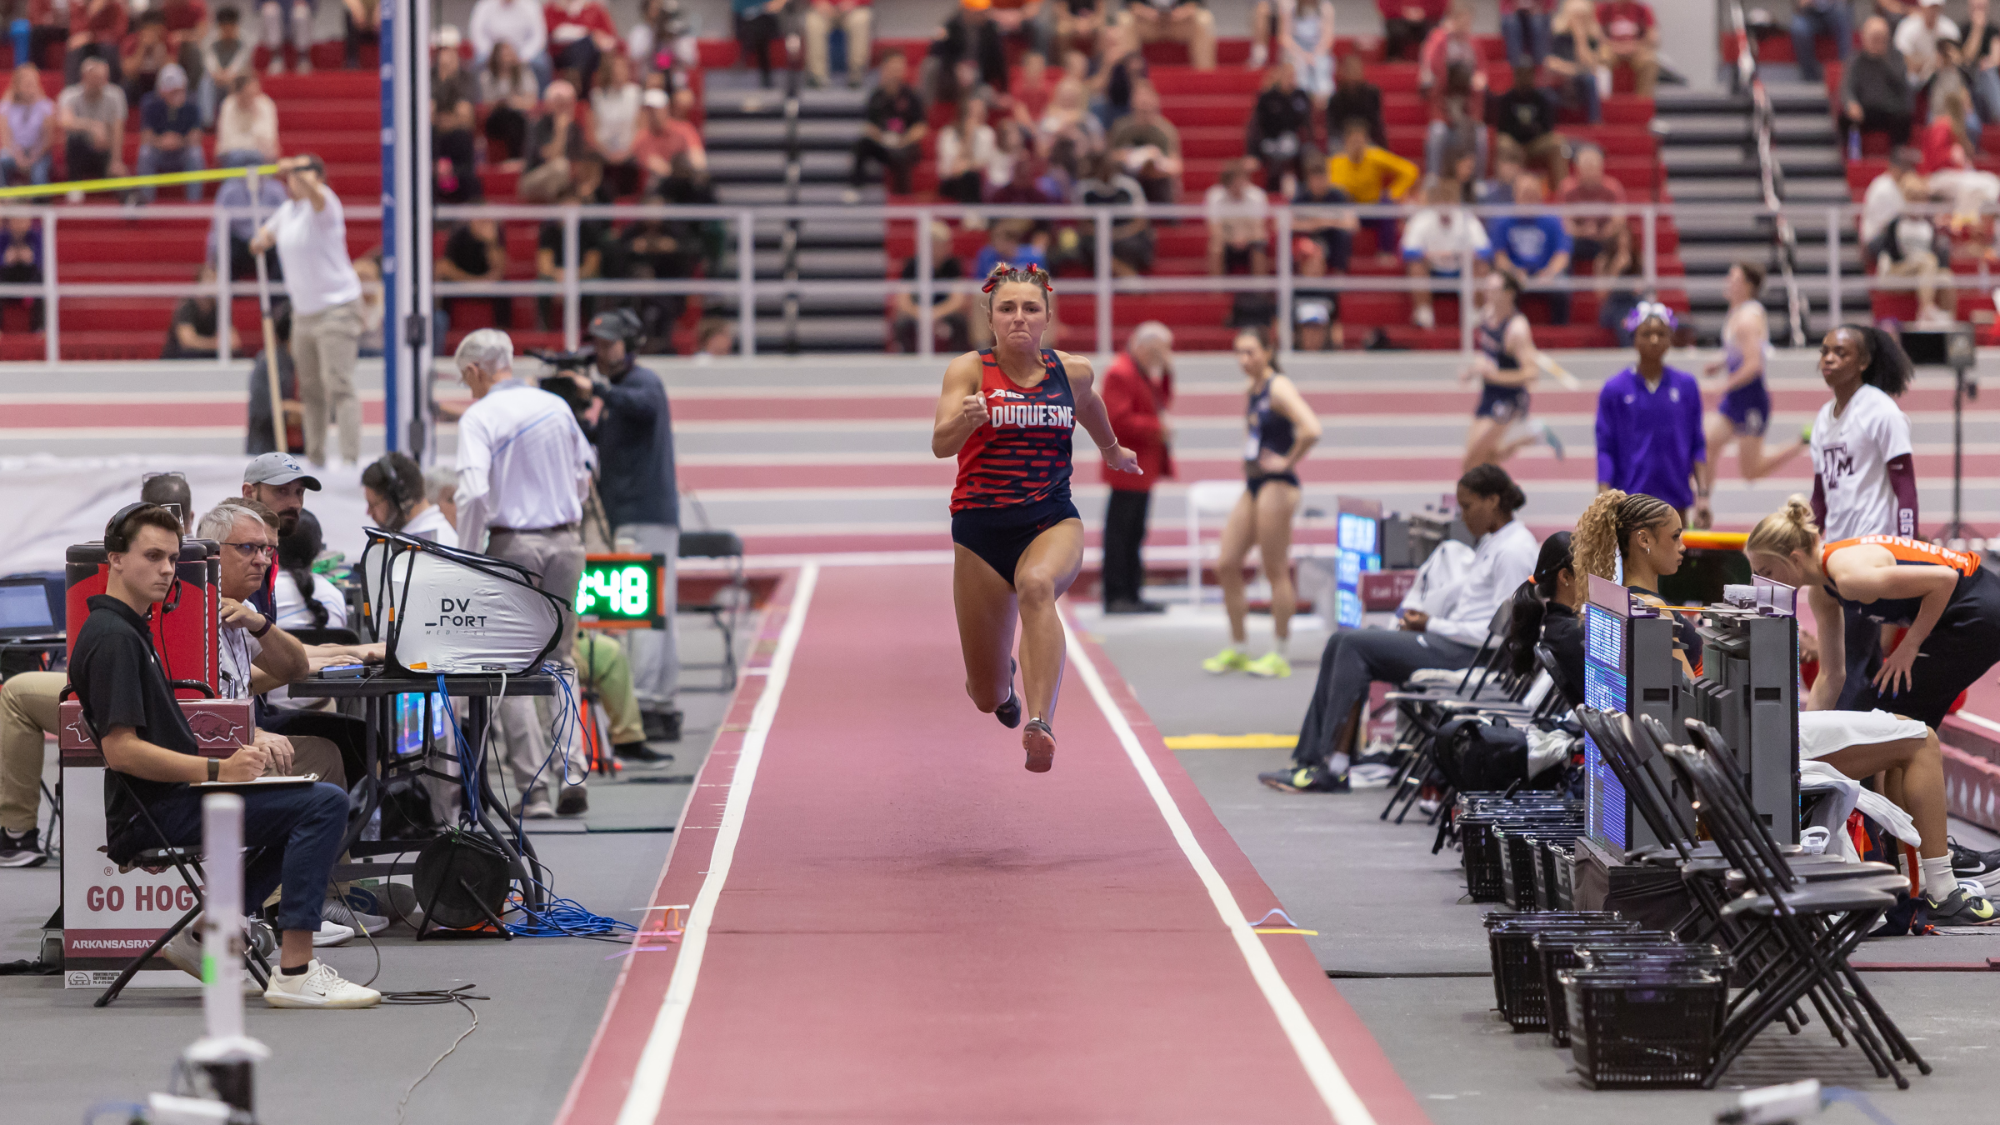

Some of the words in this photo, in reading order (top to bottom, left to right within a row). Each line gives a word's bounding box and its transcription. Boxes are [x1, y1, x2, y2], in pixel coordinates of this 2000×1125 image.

[991, 404, 1073, 428] DUQUESNE
[441, 598, 471, 613] DV
[87, 885, 125, 912] GO
[135, 885, 206, 912] HOG
[72, 939, 157, 949] ARKANSASRAZ
